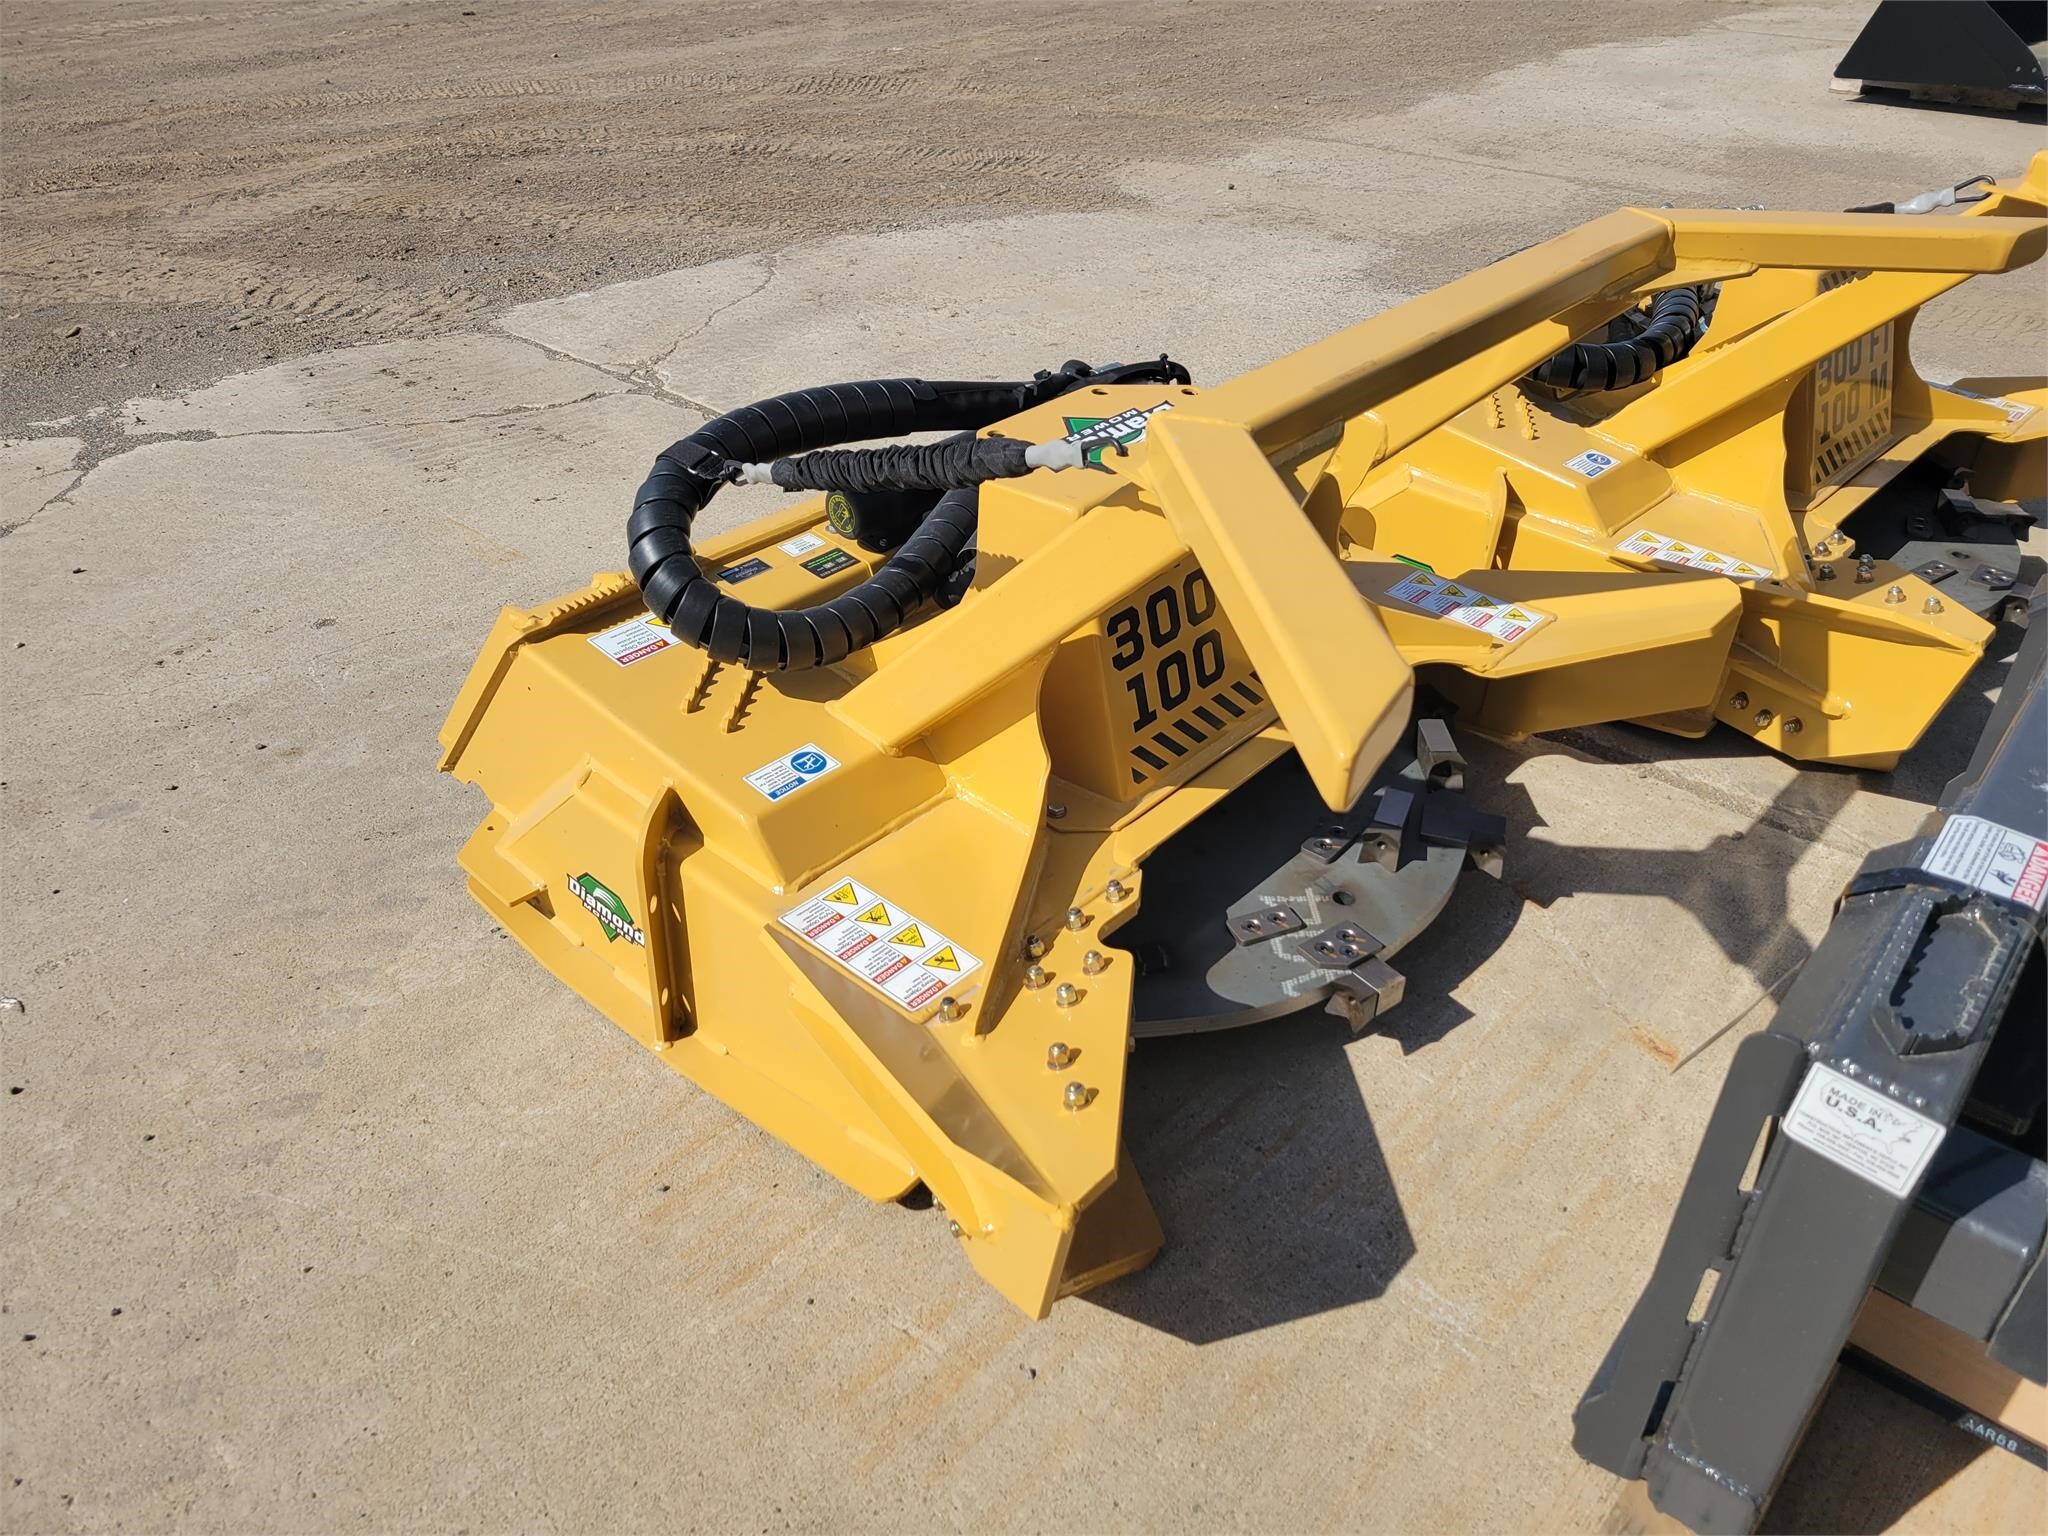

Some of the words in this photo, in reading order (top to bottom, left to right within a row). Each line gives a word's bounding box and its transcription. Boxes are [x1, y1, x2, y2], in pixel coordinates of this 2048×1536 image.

[1819, 381, 1861, 445] 100
[1870, 361, 1888, 409] M
[1066, 408, 1138, 441] MOWER
[1107, 567, 1216, 671] 300
[619, 644, 660, 663] DANGER
[1126, 628, 1226, 734] 100
[772, 780, 799, 796] NOTICE
[2013, 853, 2048, 905] DANGER
[568, 877, 645, 946] Diamond
[584, 902, 632, 941] MOWERS
[806, 917, 837, 937] DANGER
[838, 939, 871, 959] DANGER
[873, 960, 905, 982] DANGER
[908, 985, 940, 1006] DANGER
[1826, 1096, 1883, 1133] U.S.A.
[1829, 1087, 1867, 1108] MADE
[1868, 1105, 1882, 1118] IN
